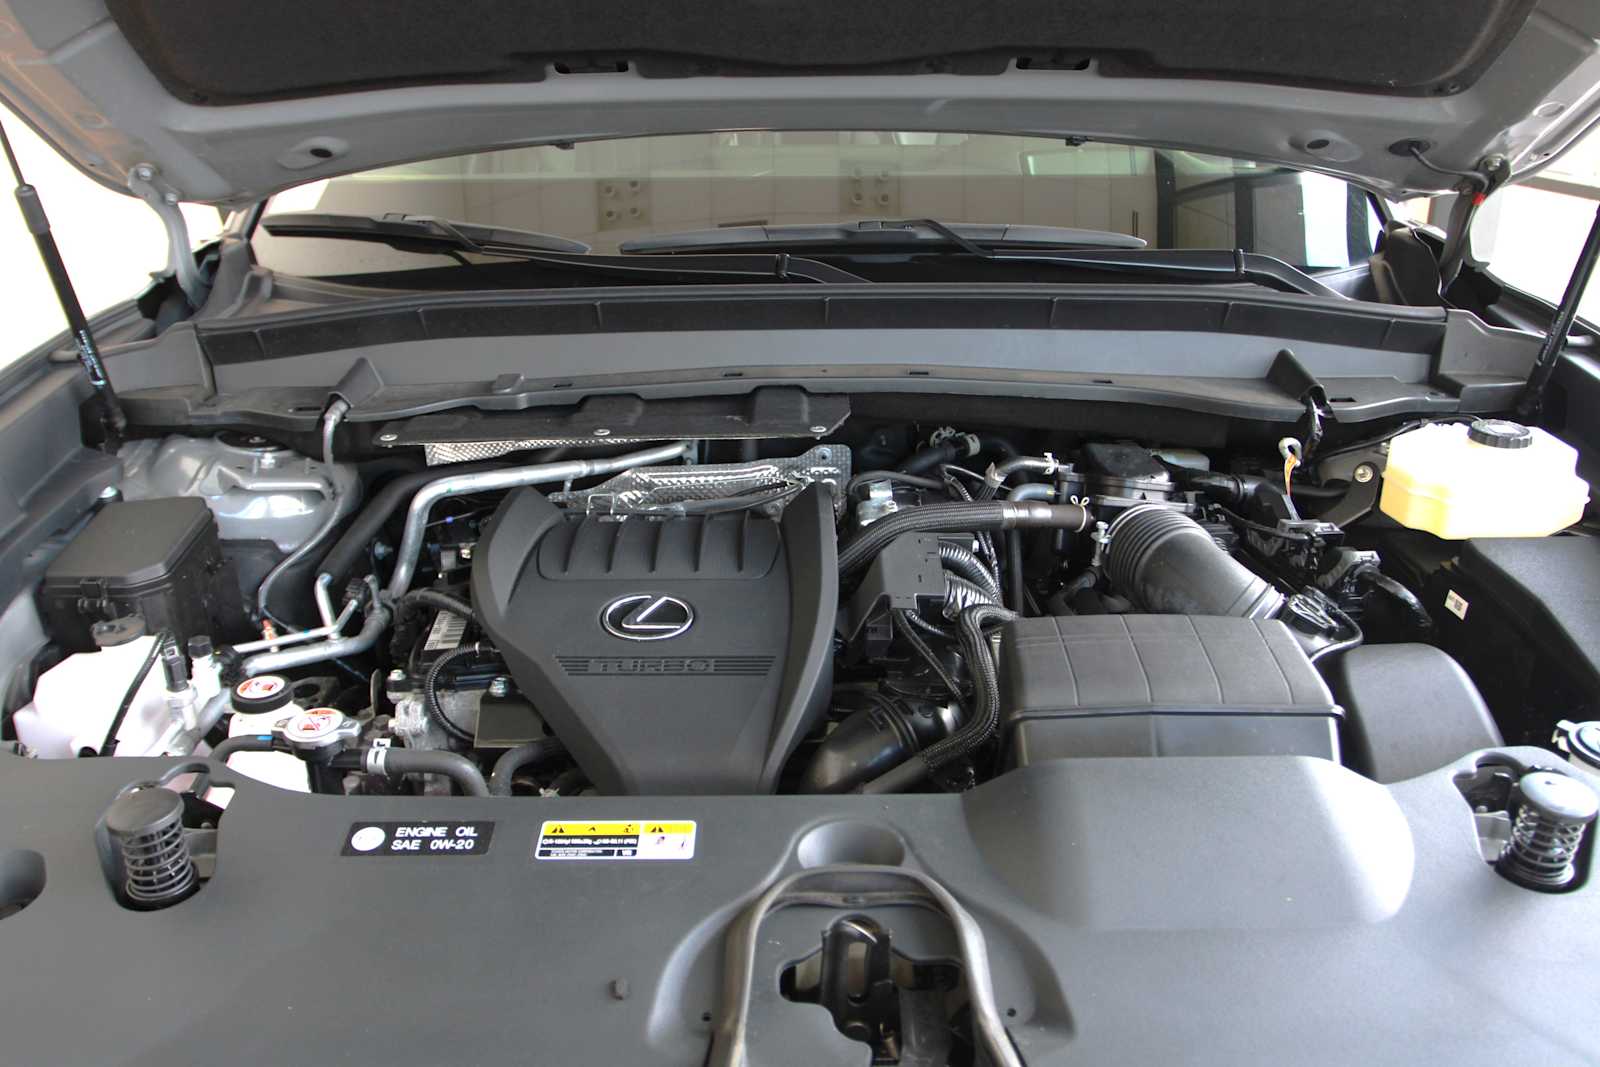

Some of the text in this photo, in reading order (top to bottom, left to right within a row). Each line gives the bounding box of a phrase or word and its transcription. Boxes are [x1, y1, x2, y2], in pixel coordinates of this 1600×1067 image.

[590, 659, 713, 673] TURBO
[395, 826, 478, 838] ENGINE OIL
[391, 839, 474, 850] SAE 0W-20
